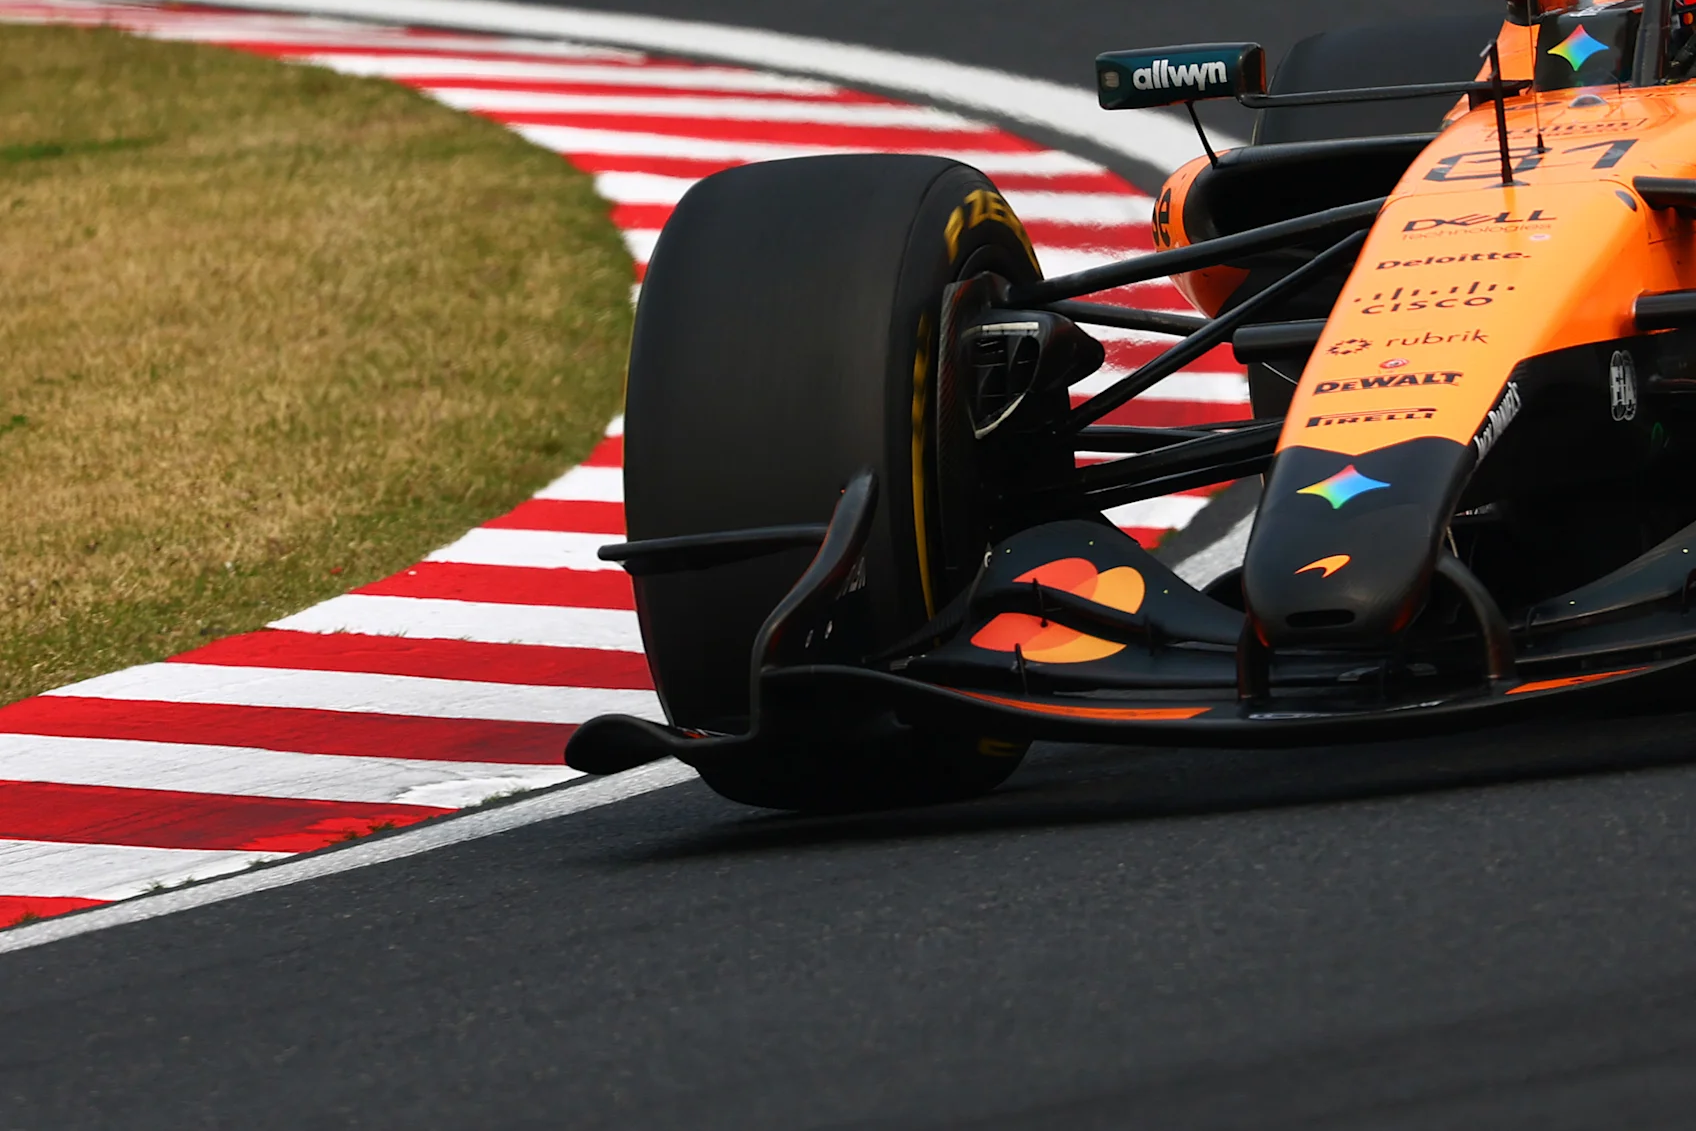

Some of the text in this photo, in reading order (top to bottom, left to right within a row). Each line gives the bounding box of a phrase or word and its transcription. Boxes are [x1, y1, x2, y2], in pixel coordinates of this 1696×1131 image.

[1133, 59, 1228, 91] allwyn
[1402, 210, 1557, 233] DELL
[1385, 328, 1489, 347] rubrik
[1312, 371, 1464, 396] DEWALT
[1305, 407, 1438, 428] PIRELLI
